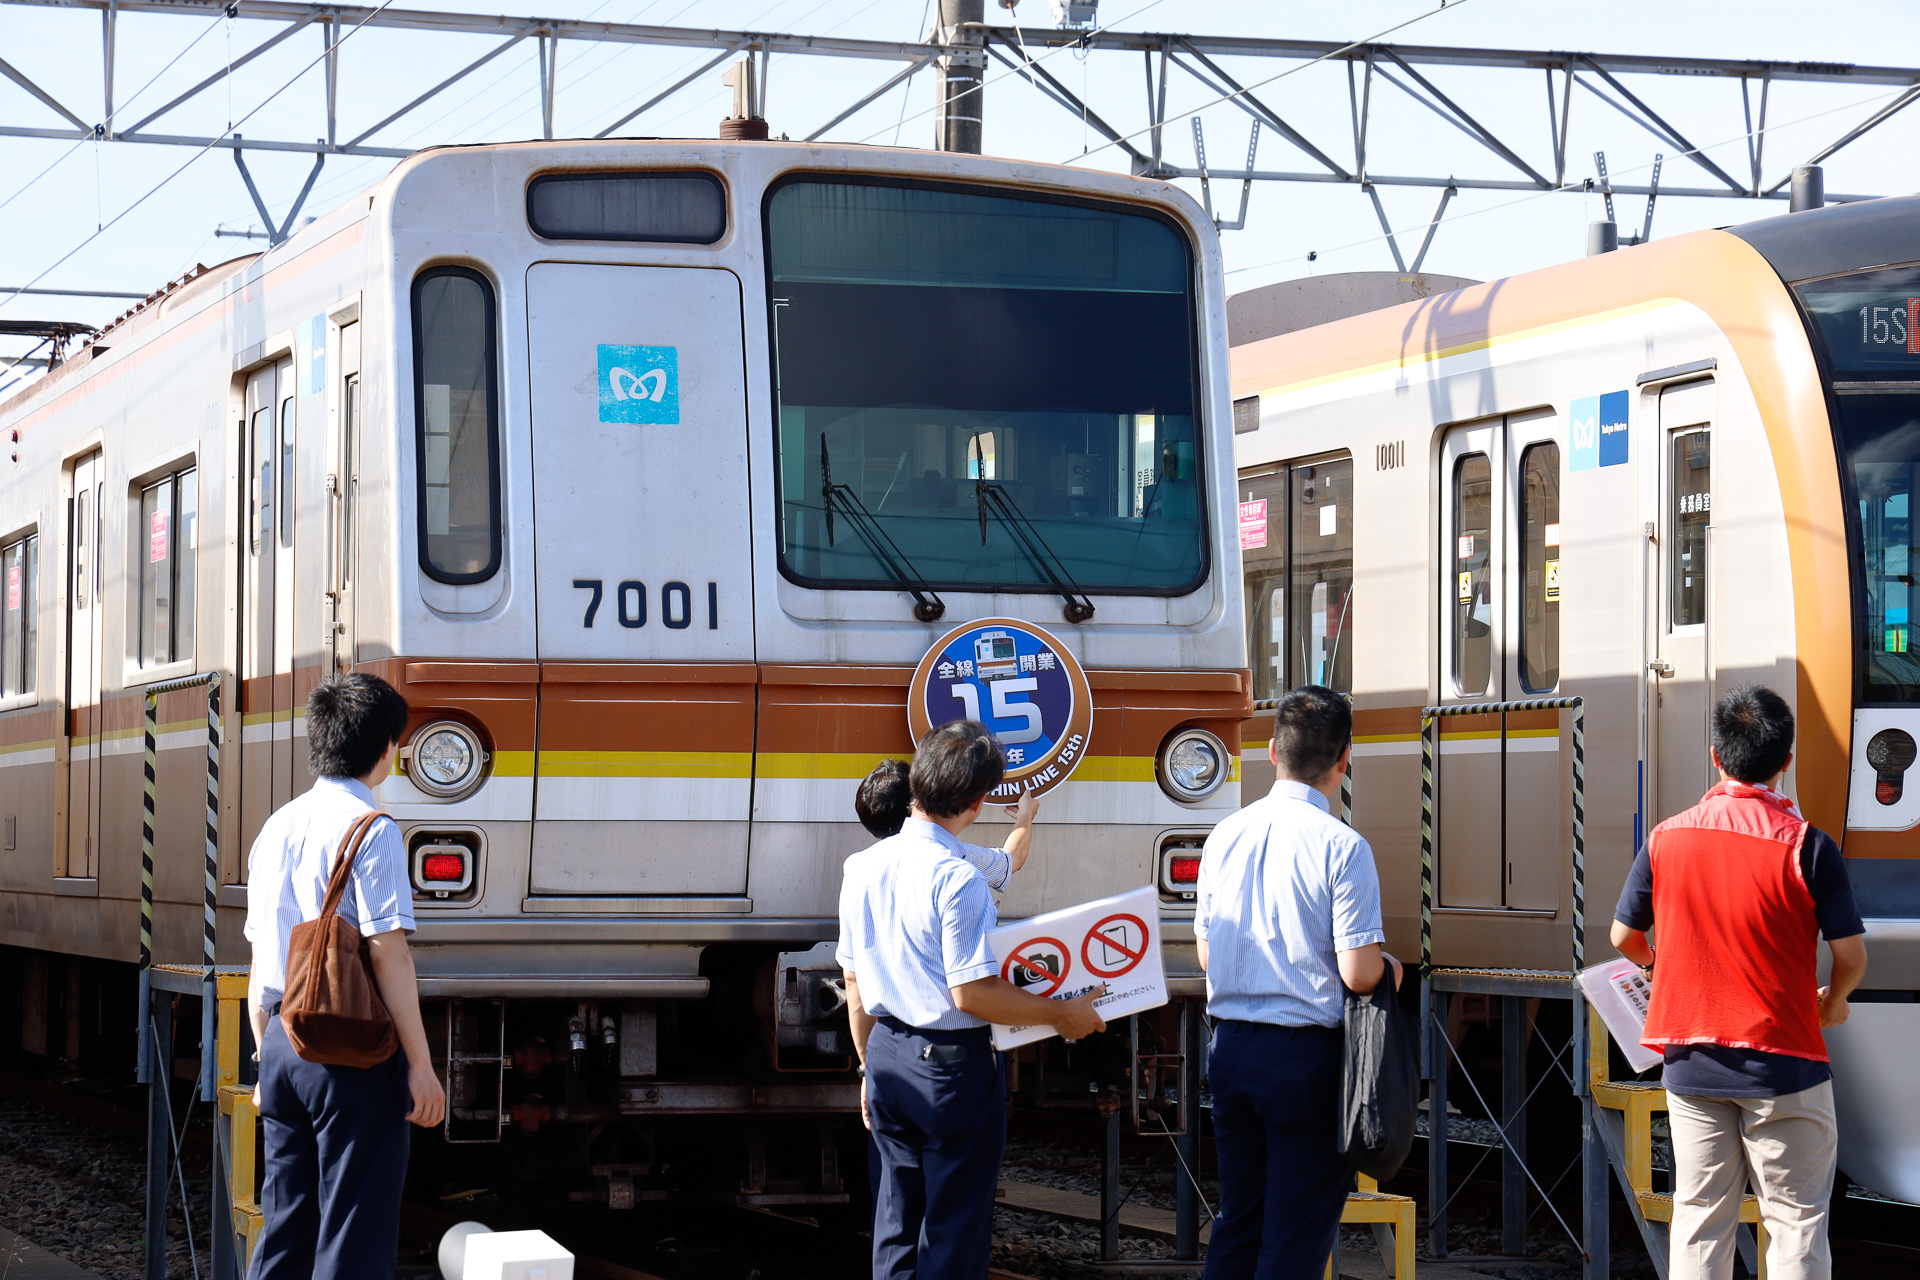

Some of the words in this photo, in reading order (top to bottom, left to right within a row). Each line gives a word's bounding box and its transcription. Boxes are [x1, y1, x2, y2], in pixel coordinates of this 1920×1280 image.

[1860, 306, 1907, 345] 15S
[1376, 440, 1405, 472] 10011
[1680, 493, 1710, 514] 乗務員室
[573, 579, 718, 630] 7001
[937, 659, 976, 680] 全線
[1018, 652, 1056, 672] 開業
[951, 677, 1043, 745] 15
[986, 781, 1021, 797] HIN
[1023, 764, 1060, 792] LINE
[1058, 734, 1084, 766] 15th
[1007, 748, 1025, 765] 年
